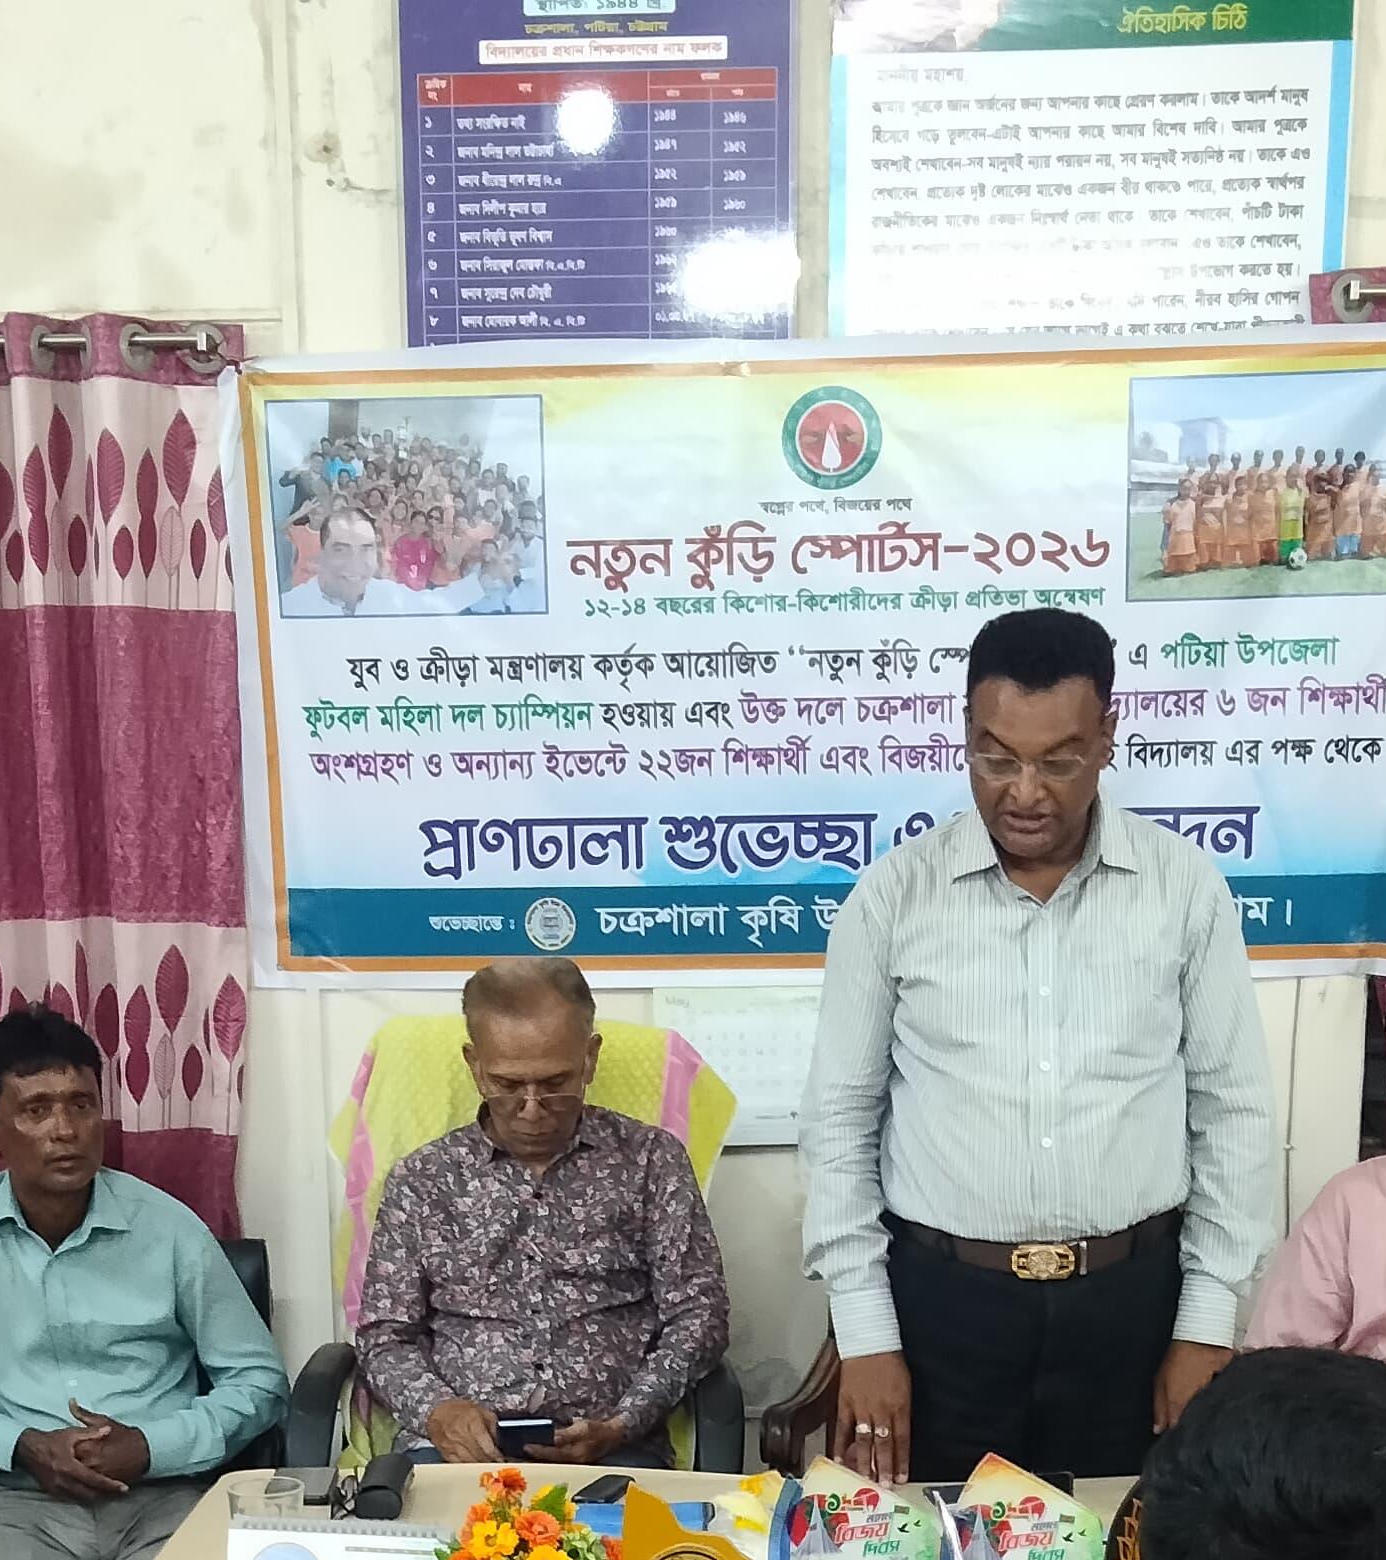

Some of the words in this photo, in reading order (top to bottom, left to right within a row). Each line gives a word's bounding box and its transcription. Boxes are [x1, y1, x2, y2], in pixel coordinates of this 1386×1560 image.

[1117, 5, 1207, 34] ঐতিহাসিক
[1212, 2, 1248, 30] চিঠি
[485, 42, 547, 58] বিদ্যালয়ের
[552, 45, 584, 57] প্রধান
[1211, 91, 1240, 106] তাকে
[1112, 123, 1146, 137] আমার
[1232, 119, 1266, 134] আমার
[1257, 147, 1287, 162] তাকে
[1242, 202, 1273, 220] পাঁচটি
[1278, 202, 1305, 219] টাকা
[1239, 263, 1271, 278] করতে
[834, 496, 882, 513] বিজয়ের
[886, 497, 913, 512] পথে
[566, 537, 673, 593] নতুন
[685, 520, 777, 591] কুঁড়ি
[791, 520, 1110, 575] স্পোর্টস-২০২৬
[584, 597, 647, 618] ১২-১৪
[654, 595, 716, 616] বছরের
[722, 585, 904, 614] কিশোর-কিশোরীদের
[910, 584, 959, 613] ক্রীড়া
[965, 583, 1028, 610] প্রতিভা
[1033, 586, 1106, 608] অন্বেষণ
[346, 657, 382, 691] যুব
[390, 658, 409, 681] ও
[416, 646, 479, 687] ক্রীড়া
[485, 652, 585, 682] মন্ত্রণালয়
[591, 642, 656, 692] কর্তৃক
[662, 641, 779, 680] আয়োজিত
[869, 638, 920, 683] কুঁড়ি
[1129, 643, 1147, 669] এ
[1161, 632, 1229, 669] পটিয়া
[1235, 632, 1340, 667] উপজেলা
[302, 697, 370, 738] ফুটবল
[376, 695, 443, 736] মহিলা
[448, 703, 486, 731] দল
[492, 693, 594, 731] চ্যাম্পিয়ন
[600, 702, 676, 733] হওয়ায়
[685, 700, 734, 729] এবং
[738, 689, 787, 724] উক্ত
[794, 697, 847, 726] দলে
[854, 692, 956, 725] চক্রশালা
[1217, 688, 1237, 716] ৬
[1245, 687, 1291, 717] জন
[309, 750, 414, 785] অংশগ্রহণ
[423, 752, 442, 778] ও
[450, 749, 536, 781] অন্যান্য
[542, 740, 629, 784] ইভেন্টে
[638, 747, 716, 781] ২২জন
[721, 735, 812, 777] শিক্ষার্থী
[820, 746, 873, 777] এবং
[1125, 733, 1217, 769] বিদ্যালয়
[1225, 739, 1263, 767] এর
[1270, 737, 1316, 766] পক্ষ
[1324, 734, 1384, 764] থেকে
[419, 816, 648, 881] প্রাণঢালা
[659, 812, 878, 876] শুভেচ্ছা
[594, 903, 729, 937] চক্রশালা
[739, 894, 802, 948] কৃষি
[835, 1521, 890, 1543] বিজয়
[999, 1530, 1054, 1551] বিজয়
[862, 1540, 902, 1558] দিবস
